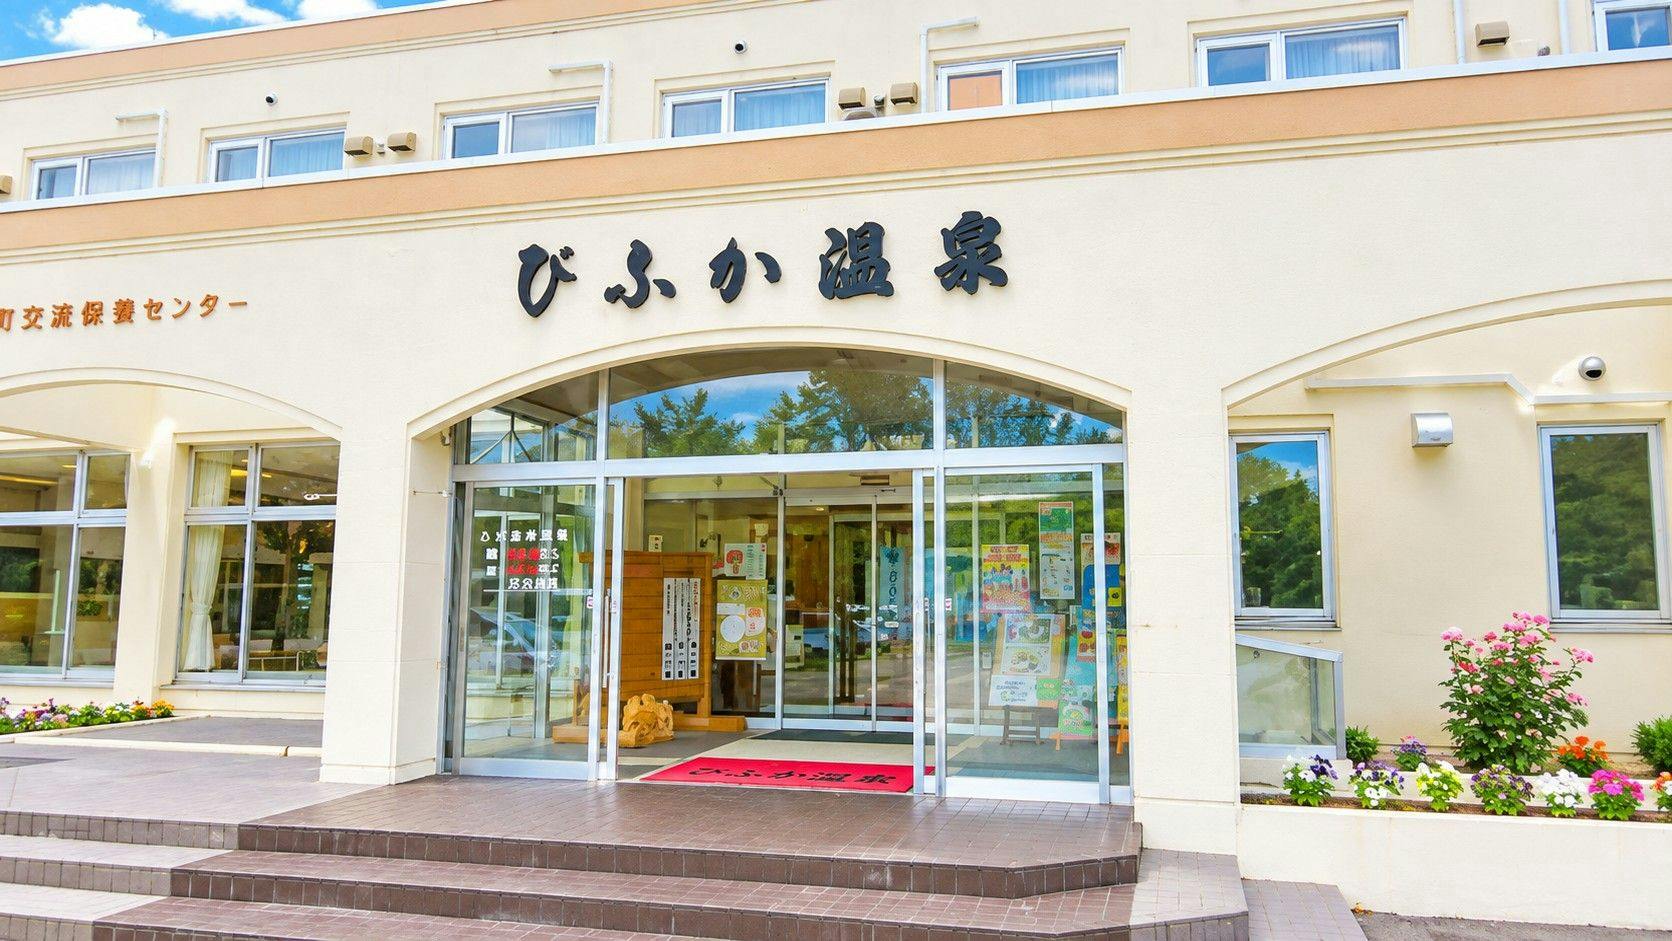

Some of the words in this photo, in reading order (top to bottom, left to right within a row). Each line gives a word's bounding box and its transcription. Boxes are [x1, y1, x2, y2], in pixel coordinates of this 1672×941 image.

[518, 211, 1008, 318] びふか温泉
[688, 766, 897, 785] びふか温泉
